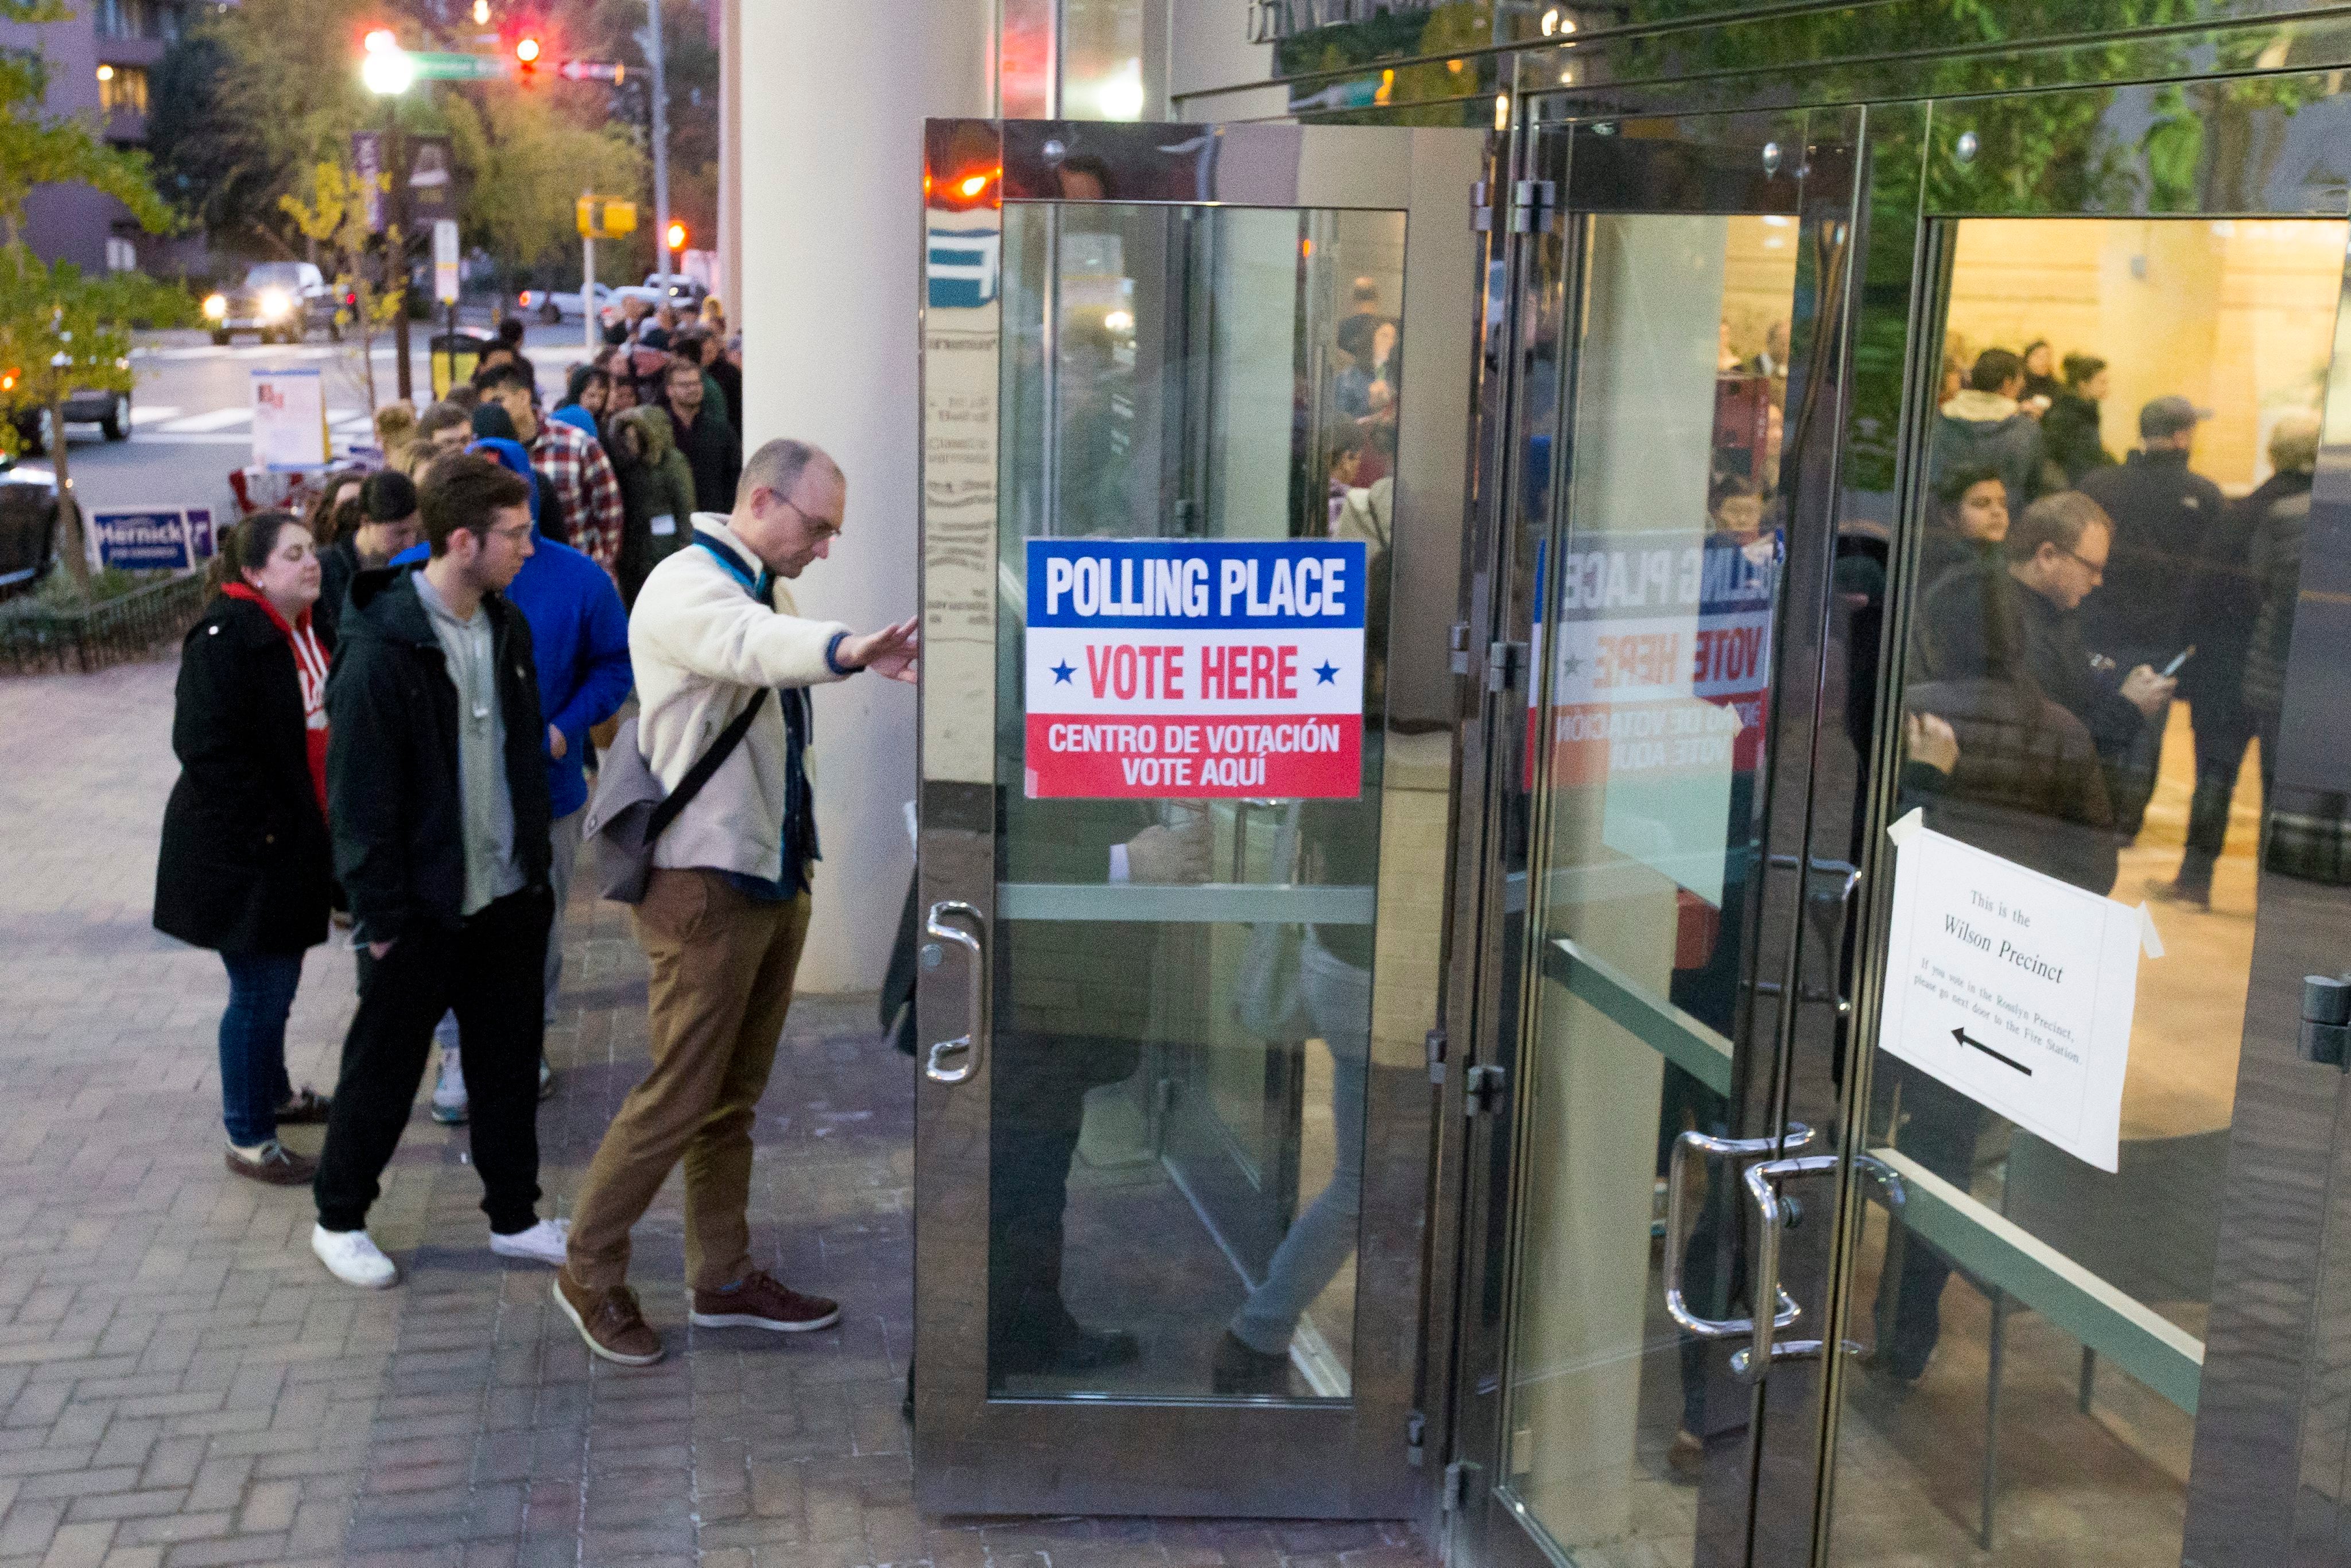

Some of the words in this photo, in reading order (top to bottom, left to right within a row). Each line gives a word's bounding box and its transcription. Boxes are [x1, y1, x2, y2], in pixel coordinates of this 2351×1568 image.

[1046, 557, 1209, 618] POLLING
[1220, 557, 1345, 616] PLACE
[1086, 644, 1184, 700] VOTE
[1201, 645, 1298, 700] HERE
[1049, 724, 1157, 753] CENTRO
[1164, 725, 1200, 754] DE
[1206, 718, 1340, 754] VOTACIÓN
[1122, 757, 1191, 786] VOTE
[1200, 752, 1265, 788] AQUÍ
[1972, 890, 1993, 911] This
[1998, 902, 2007, 918] is
[2013, 909, 2031, 927] the
[1945, 914, 1991, 952] Wilson
[1999, 939, 2063, 984] Precinct
[1914, 976, 1937, 992] please
[1939, 988, 1949, 999] go
[1952, 995, 1969, 1008] next
[1972, 1003, 1991, 1020] door
[1994, 1014, 2002, 1025] to
[2006, 1020, 2019, 1034] the
[2024, 1028, 2042, 1045] Fire
[1922, 957, 1929, 969] If
[1932, 966, 1945, 978] you
[1967, 980, 1976, 993] in
[1980, 988, 1992, 1002] the
[1997, 995, 2029, 1020] Rosslyn
[2034, 1012, 2074, 1043] Precinct,
